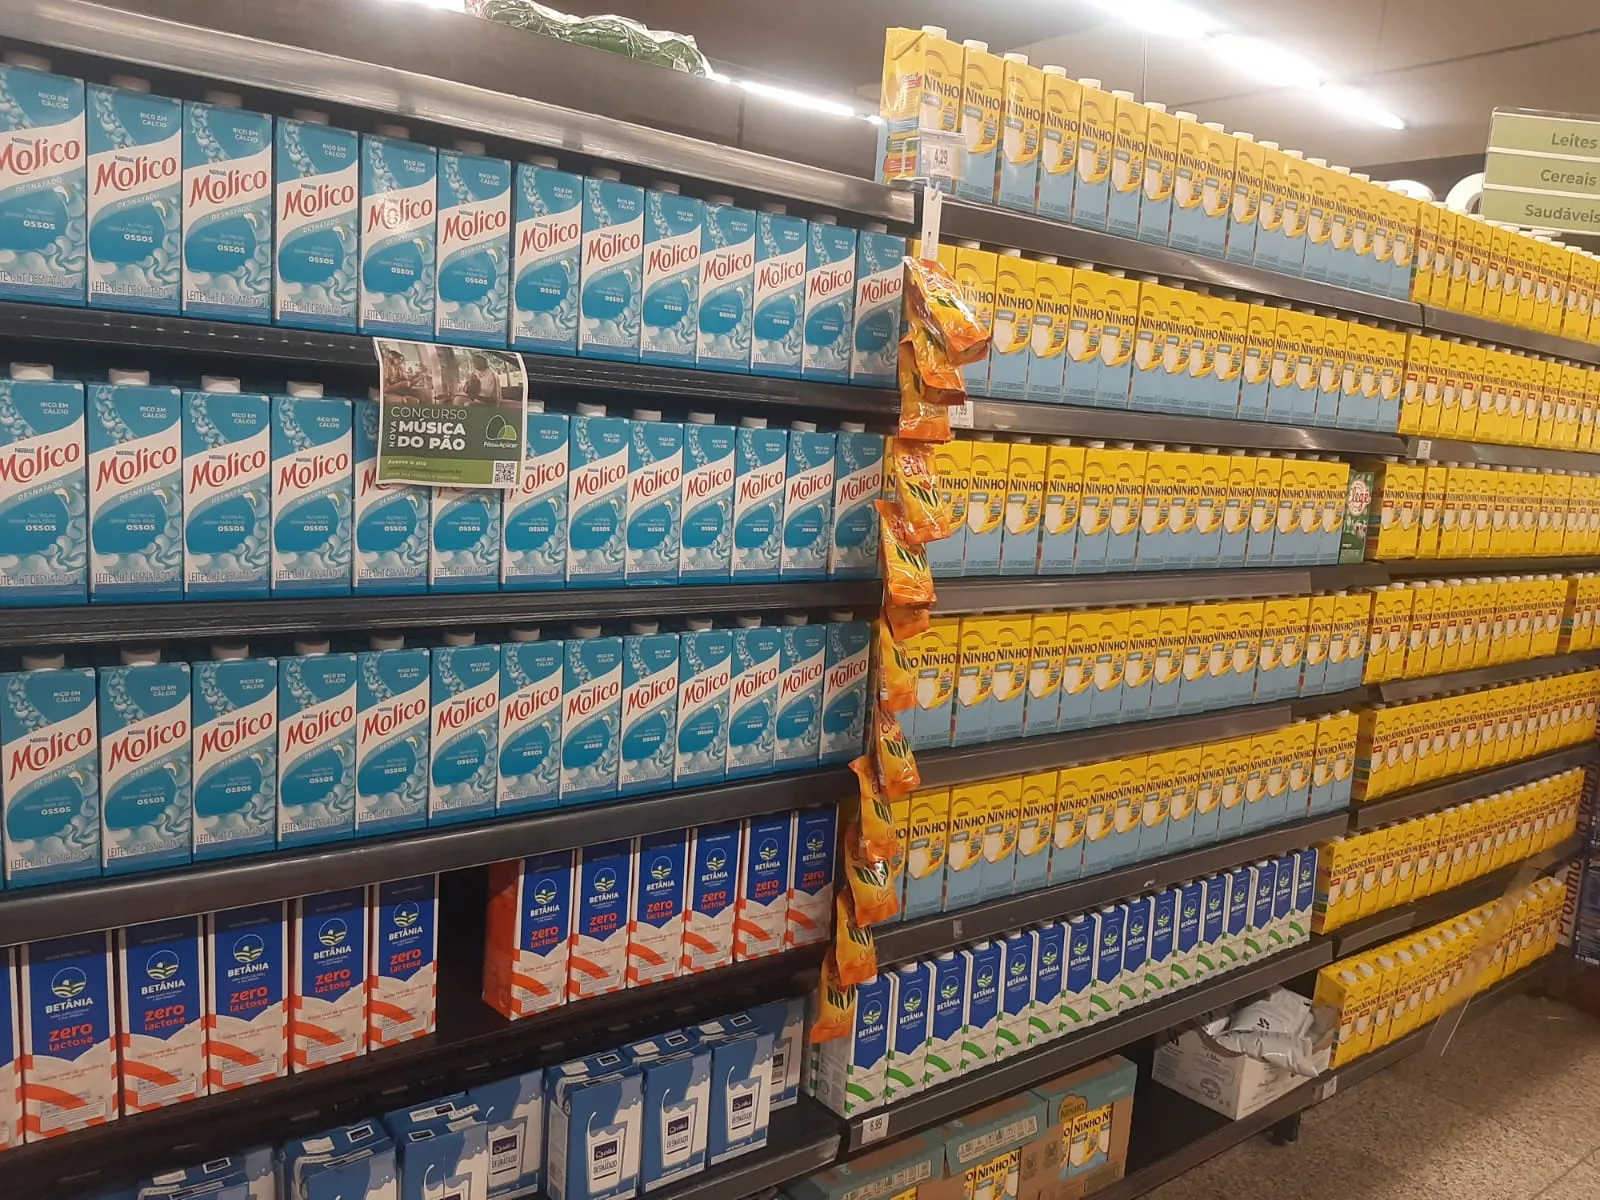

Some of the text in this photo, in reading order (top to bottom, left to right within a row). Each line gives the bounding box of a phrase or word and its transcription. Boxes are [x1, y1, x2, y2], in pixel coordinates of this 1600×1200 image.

[924, 76, 959, 99] NINHO
[966, 87, 1000, 110] NINHO
[1007, 99, 1040, 121] NINHO
[1047, 111, 1077, 132] NINHO
[1082, 122, 1112, 143] NINHO
[1552, 132, 1598, 149] Leites
[1117, 134, 1144, 153] NINHO
[1150, 144, 1175, 162] NINHO
[1180, 153, 1206, 170] NINHO
[94, 156, 176, 195] Molico
[1207, 164, 1232, 180] NINHO
[1541, 169, 1597, 186] Cereais
[189, 169, 267, 207] Molico
[282, 185, 354, 220] Molico
[367, 199, 433, 233] Molico
[1525, 204, 1600, 223] Saudáveis
[23, 220, 56, 230] OSSOS
[442, 210, 506, 244] Molico
[124, 233, 153, 243] OSSOS
[520, 223, 578, 255] Molico
[586, 234, 640, 265] Molico
[309, 257, 334, 265] OSSOS
[648, 244, 698, 274] Molico
[704, 254, 751, 283] Molico
[758, 262, 803, 291] Molico
[809, 270, 852, 299] Molico
[860, 278, 901, 306] Molico
[998, 293, 1033, 309] NINHO
[1036, 300, 1068, 315] NINHO
[1073, 306, 1103, 320] NINHO
[1106, 311, 1135, 326] NINHO
[1140, 316, 1168, 331] NINHO
[1167, 321, 1193, 335] NINHO
[1249, 336, 1273, 348] NINHO
[1301, 344, 1323, 355] NINHO
[391, 407, 467, 419] CONCURSO
[389, 421, 397, 447] NOVA
[399, 418, 466, 435] MÚSICA
[398, 435, 466, 450] DO PÃO
[96, 446, 176, 491] Molico
[189, 451, 265, 494] Molico
[278, 453, 348, 495] Molico
[524, 463, 565, 494] olico
[574, 465, 625, 500] Molico
[632, 467, 679, 501] Molico
[686, 469, 731, 504] Molico
[972, 477, 1005, 489] NINHO
[1010, 479, 1042, 491] NINHO
[1050, 480, 1080, 493] NINHO
[739, 472, 783, 504] Molico
[789, 473, 831, 503] Molico
[839, 474, 879, 504] Molico
[1085, 482, 1113, 494] NINHO
[1116, 483, 1143, 494] NINHO
[1147, 484, 1173, 495] NINHO
[1201, 486, 1226, 496] NINHO
[1282, 488, 1303, 499] NINHO
[1033, 645, 1063, 658] NINHO
[1068, 643, 1097, 656] NINHO
[1099, 641, 1126, 653] NINHO
[1130, 638, 1156, 650] NINHO
[921, 652, 956, 666] NINHO
[962, 651, 995, 664] NINHO
[998, 648, 1028, 661] NINHO
[781, 663, 822, 698] Molico
[828, 659, 867, 693] Molico
[683, 672, 728, 710] Molico
[733, 667, 777, 703] Molico
[567, 681, 619, 722] Molico
[626, 677, 675, 715] Molico
[436, 693, 496, 736] Molico
[504, 686, 559, 728] Molico
[285, 706, 353, 752] Molico
[362, 699, 426, 744] Molico
[198, 712, 272, 761] Molico
[108, 720, 186, 771] Molico
[9, 727, 92, 781] Molico
[1224, 762, 1248, 776] NINHO
[1147, 779, 1172, 792] NINHO
[137, 797, 165, 805] OSSOS
[1059, 798, 1088, 812] NINHO
[1091, 791, 1118, 804] NINHO
[41, 807, 71, 815] OSSOS
[988, 808, 1018, 823] NINHO
[1023, 802, 1053, 818] NINHO
[912, 822, 946, 838] NINHO
[952, 815, 985, 831] NINHO
[756, 879, 779, 890] zero
[589, 892, 619, 904] BETÂNIA
[702, 890, 726, 902] zero
[530, 905, 560, 917] BETÂNIA
[647, 900, 673, 913] zero
[590, 912, 618, 926] zero
[389, 926, 423, 941] BETÂNIA
[532, 926, 559, 940] zero
[314, 945, 352, 960] BETÂNIA
[390, 949, 421, 965] zero
[228, 963, 269, 978] BETÂNIA
[316, 968, 350, 985] zero
[141, 979, 185, 995] BETÂNIA
[231, 986, 268, 1004] zero
[315, 981, 351, 994] lactose
[46, 997, 94, 1014] BETÂNIA
[144, 1004, 185, 1022] zero
[230, 998, 268, 1012] lactose
[144, 1016, 186, 1031] lactose
[858, 1024, 884, 1038] BETÂNIA
[49, 1022, 93, 1042] zero
[49, 1036, 94, 1052] lactose
[1074, 1114, 1100, 1134] NINHO
[978, 1160, 1008, 1180] NINHO
